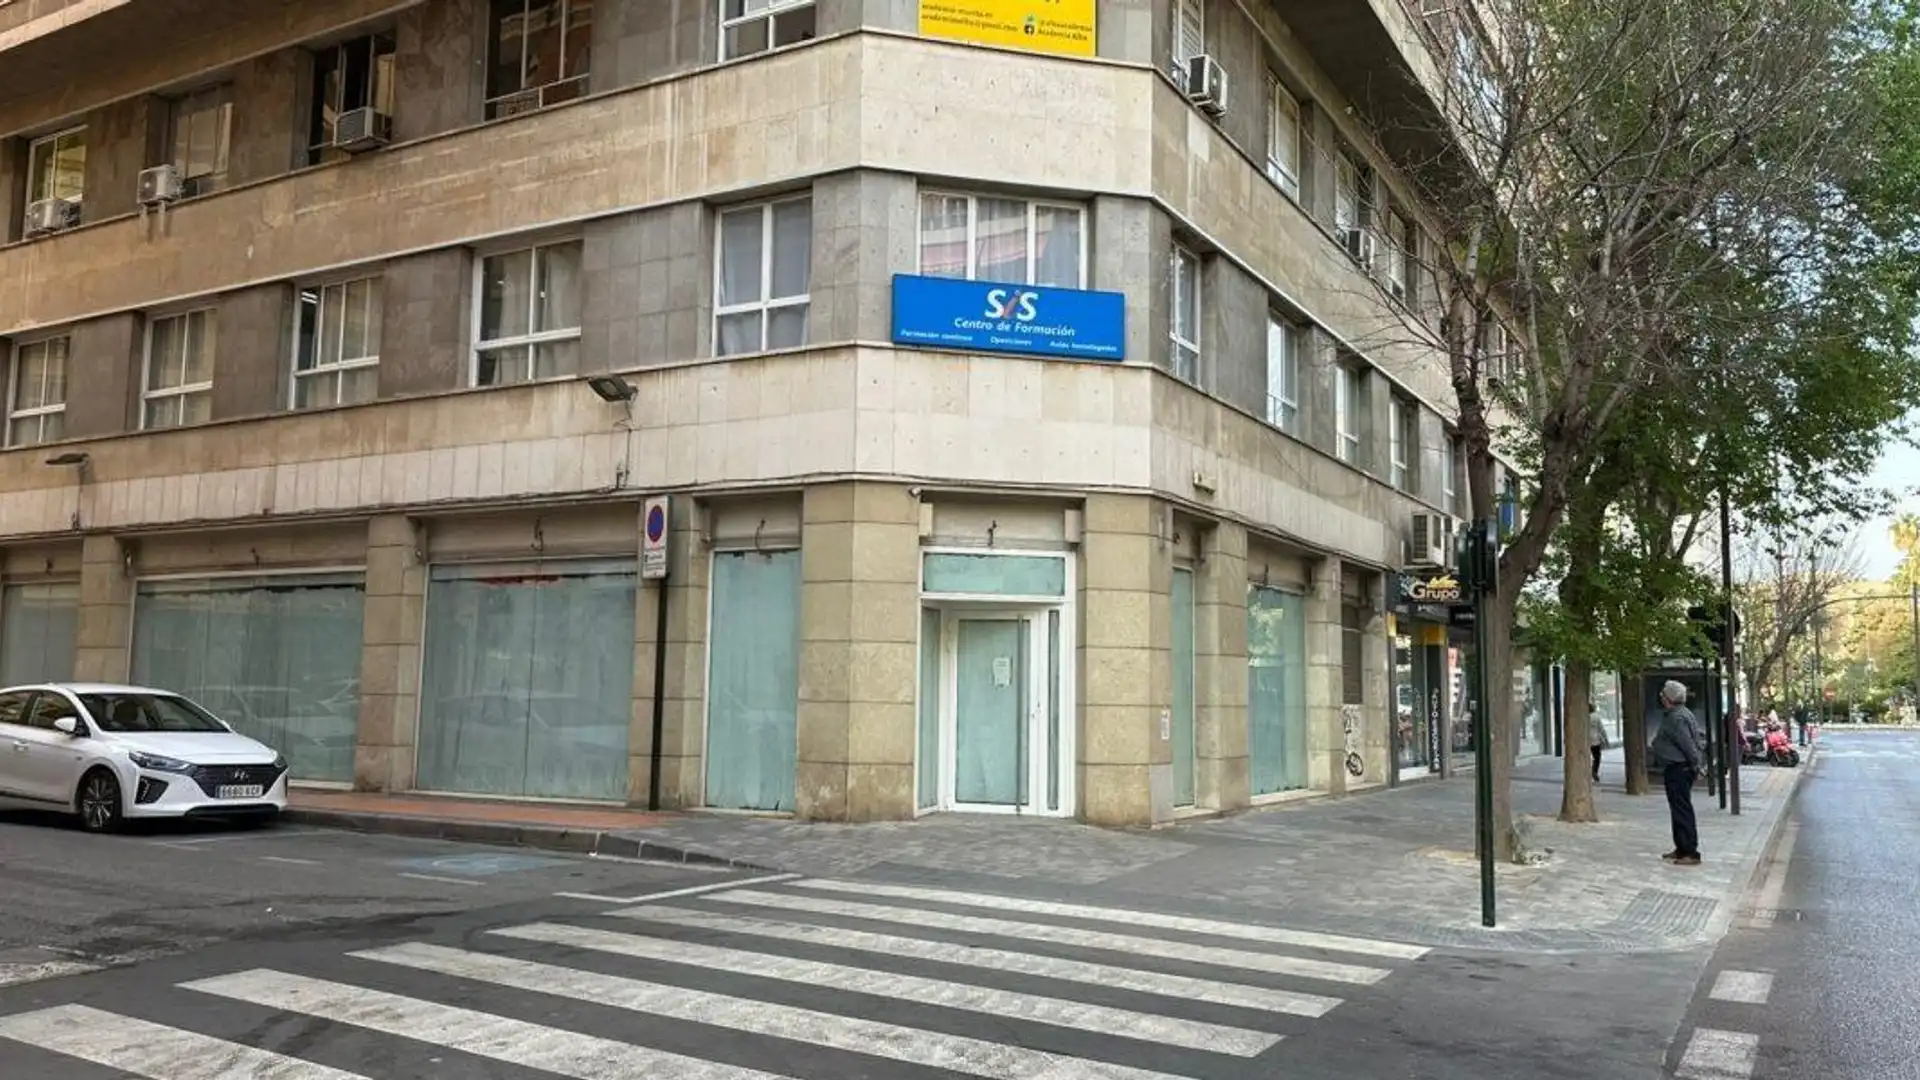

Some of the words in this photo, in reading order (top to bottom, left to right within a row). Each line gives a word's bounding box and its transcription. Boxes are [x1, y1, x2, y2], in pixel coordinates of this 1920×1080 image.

[954, 317, 993, 331] Centro
[996, 320, 1012, 332] de
[1014, 321, 1076, 337] Formación
[1408, 580, 1460, 601] Grupo
